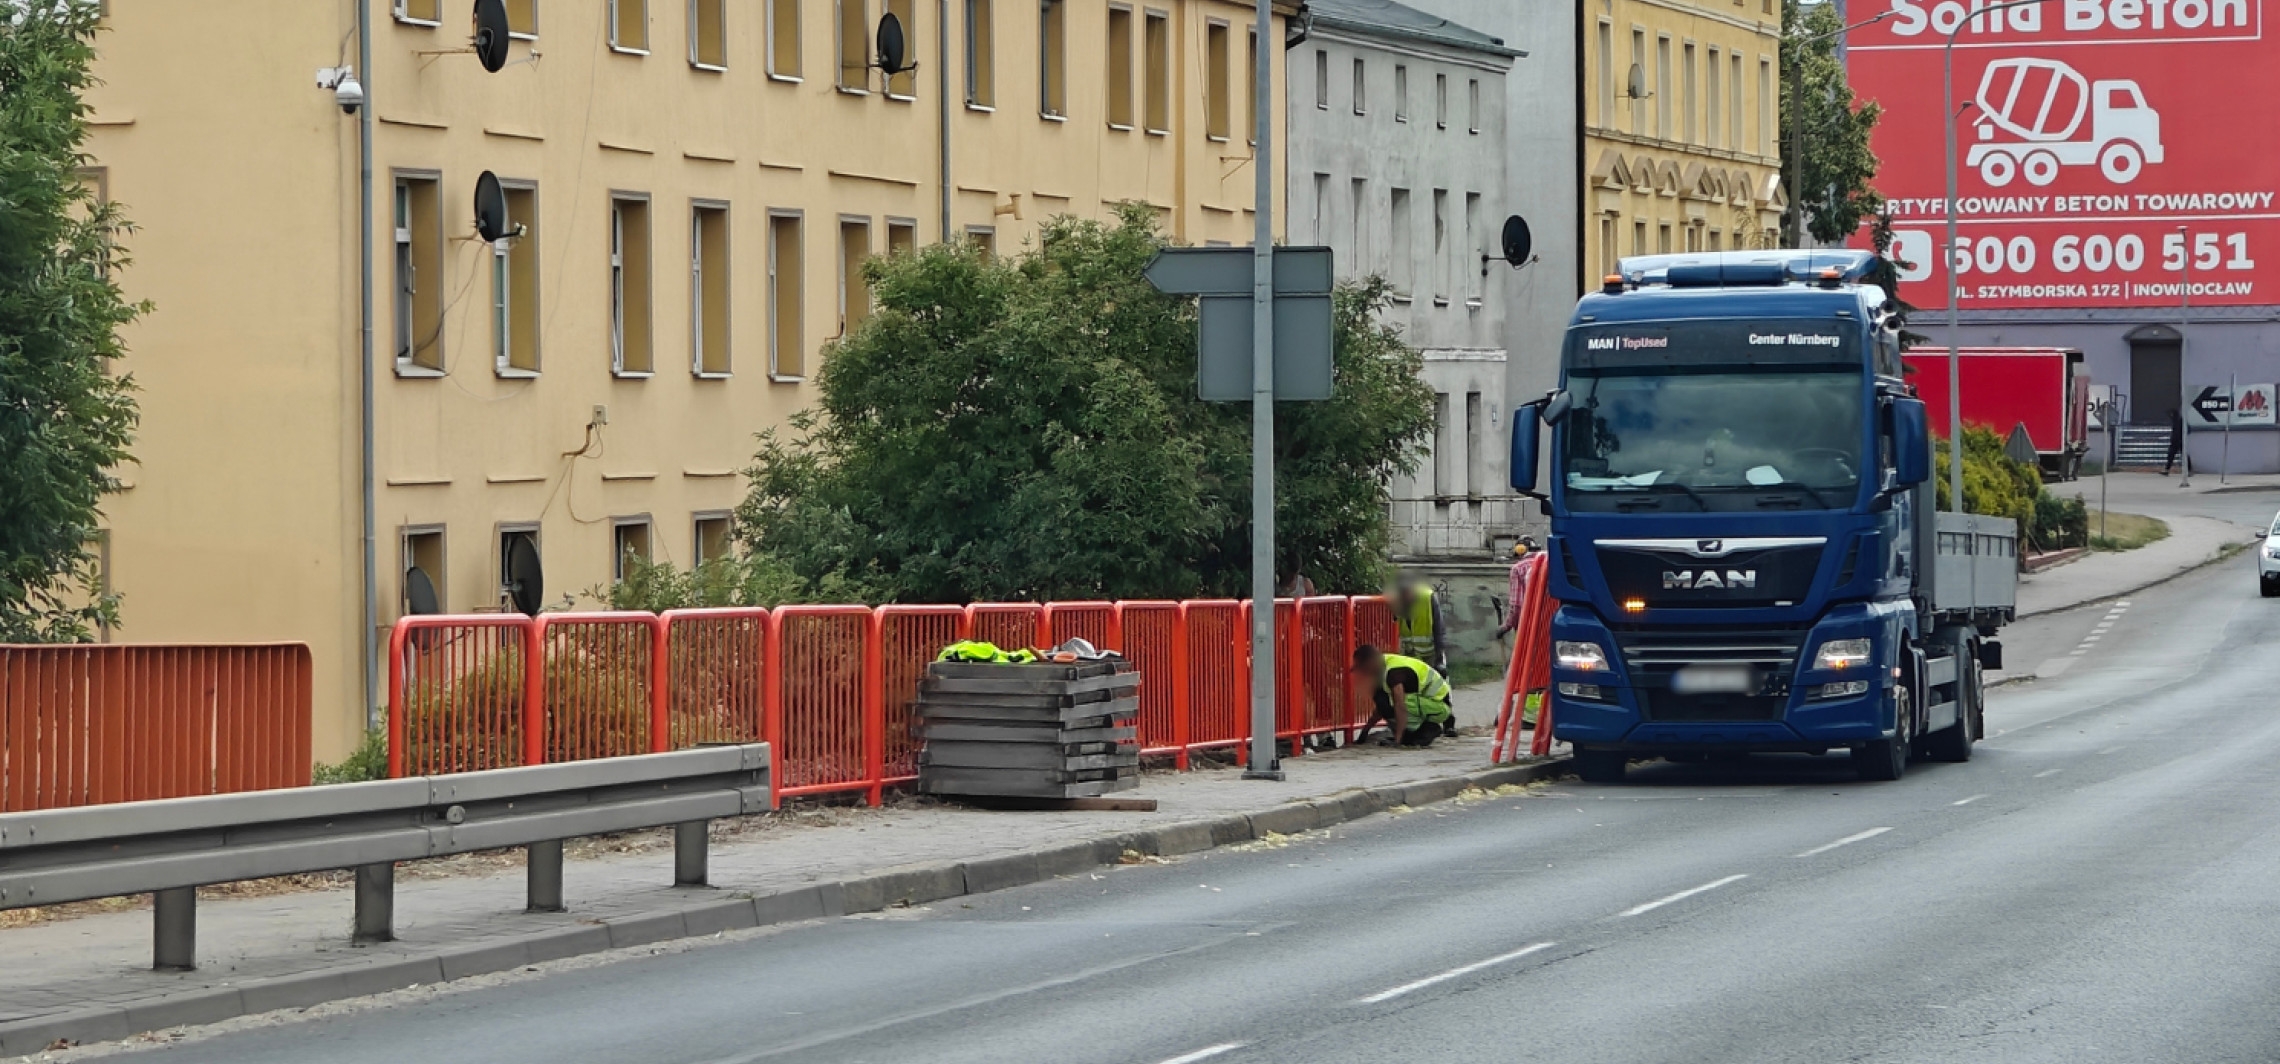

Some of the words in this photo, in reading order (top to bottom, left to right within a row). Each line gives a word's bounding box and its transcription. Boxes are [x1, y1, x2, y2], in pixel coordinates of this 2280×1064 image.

[1891, 0, 2041, 36] Solid
[2064, 0, 2247, 31] Beton
[1874, 196, 2049, 215] ERTYFIKOWANY
[2054, 195, 2130, 212] BETON
[2134, 191, 2274, 210] TOWAROWY
[1944, 235, 2036, 274] 600
[2052, 234, 2145, 272] 600
[2162, 232, 2255, 271] 551
[1978, 284, 2088, 299] SZYMBORSKA
[2092, 283, 2120, 297] 172
[2133, 282, 2253, 297] INOWROCŁAW
[1588, 338, 1614, 350] MAN
[1622, 336, 1668, 350] TopUsed
[1748, 333, 1786, 345] Center
[1788, 332, 1840, 348] Nürnberg
[1662, 570, 1756, 589] MAN
